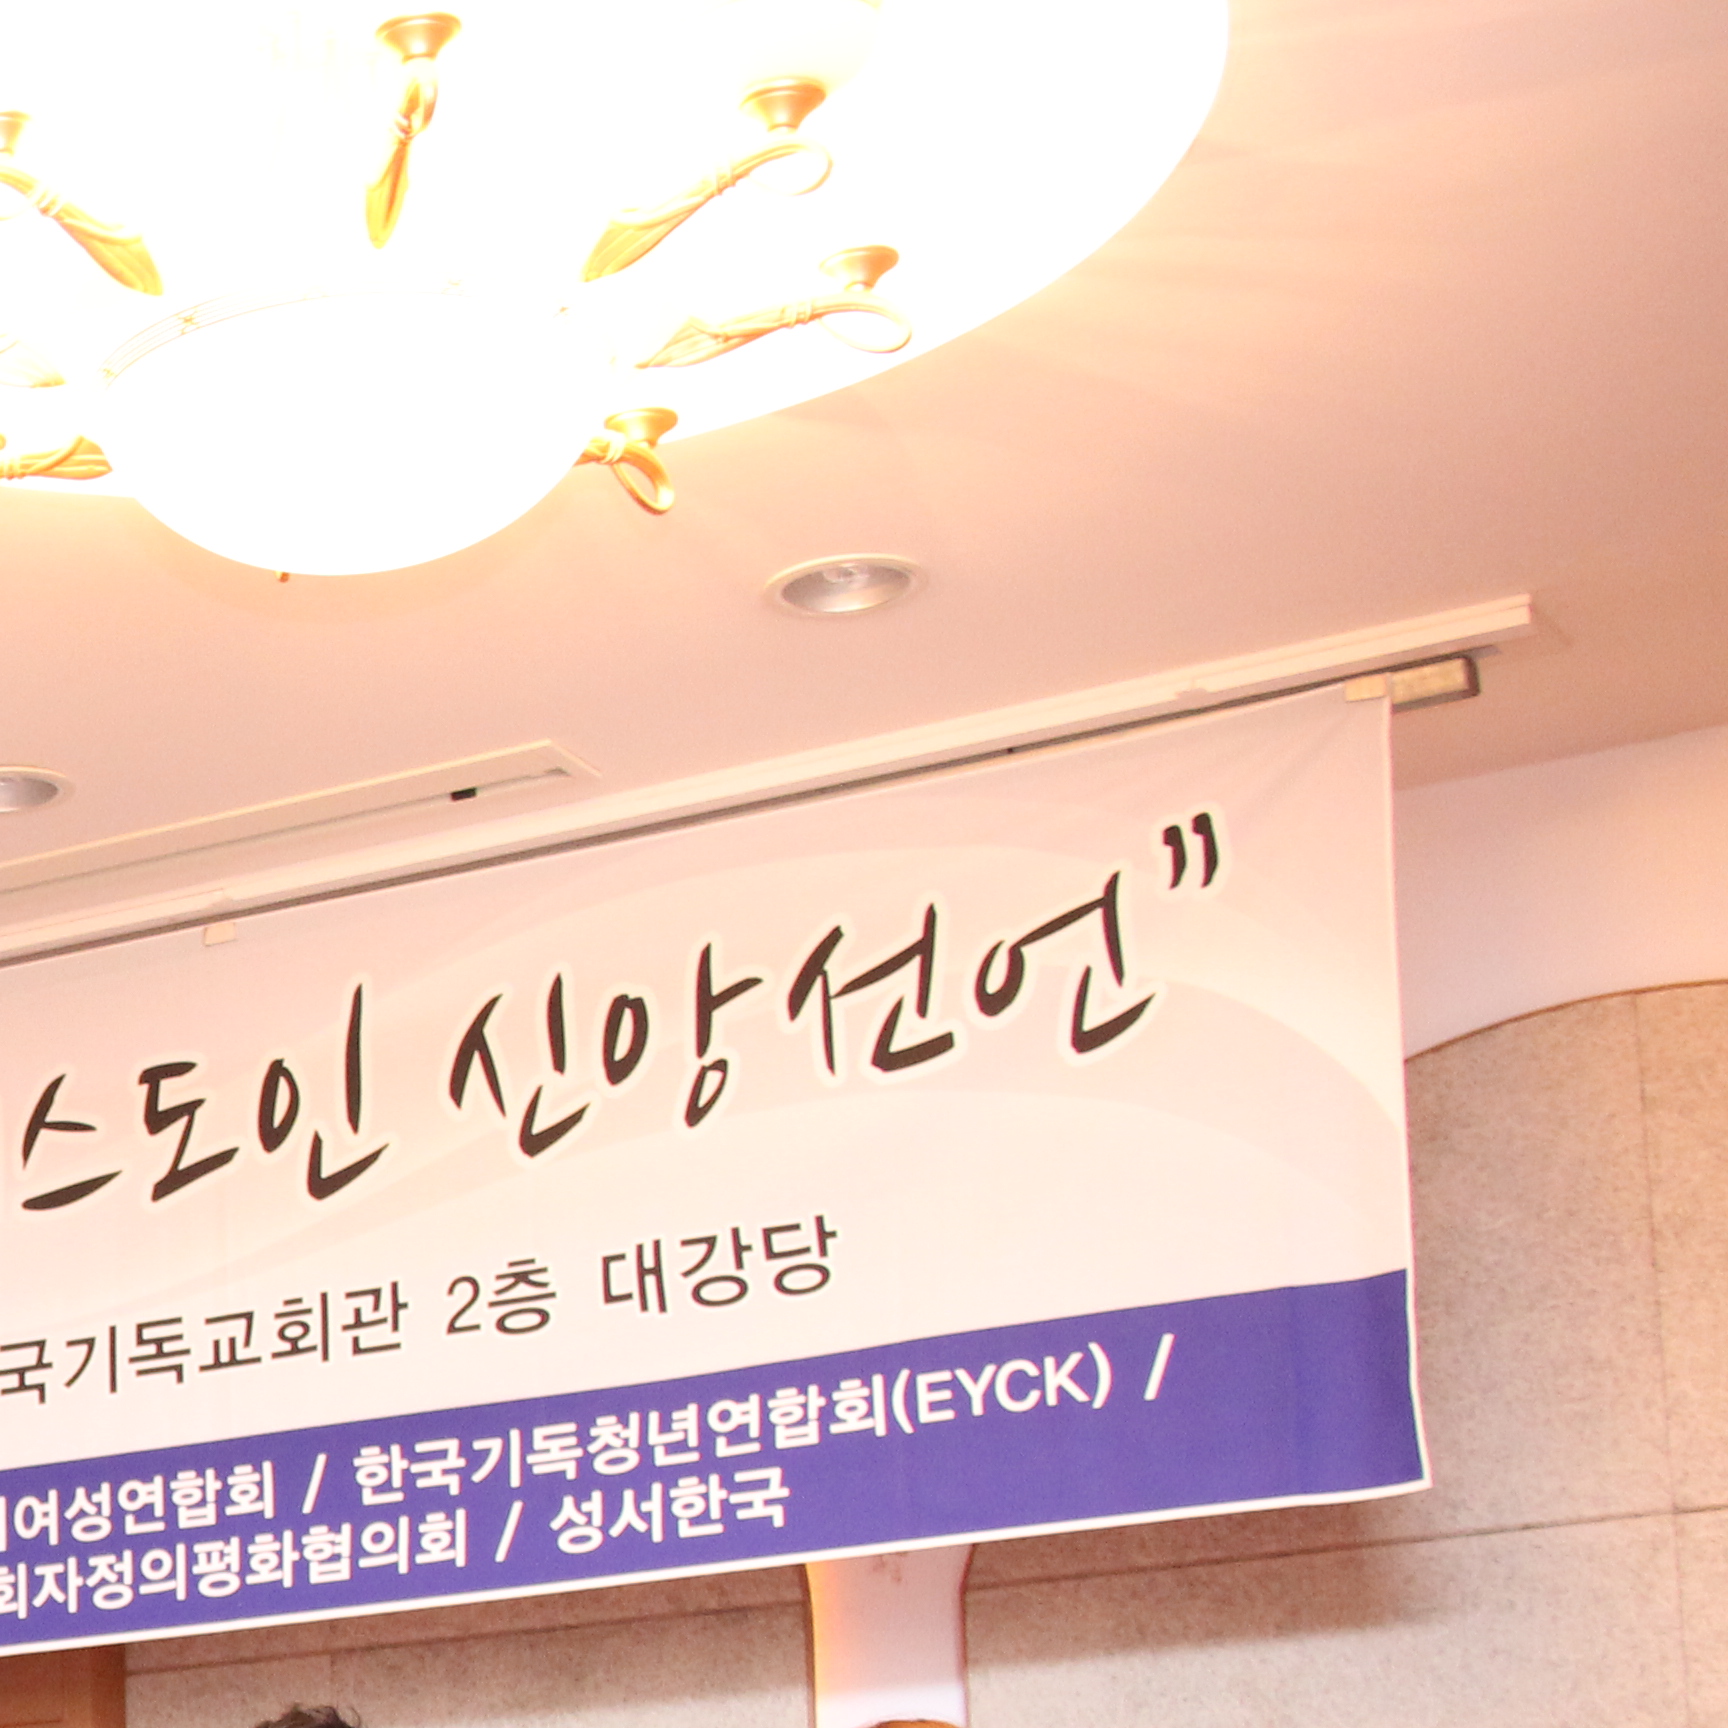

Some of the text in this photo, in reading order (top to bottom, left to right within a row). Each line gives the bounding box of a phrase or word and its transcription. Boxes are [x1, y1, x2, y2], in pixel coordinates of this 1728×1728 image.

[445, 1257, 554, 1337] 2층
[601, 1214, 839, 1315] 대강당
[353, 1341, 1113, 1506] 한국기독청년연합회(EYCK)
[550, 1466, 790, 1555] 성서한국
